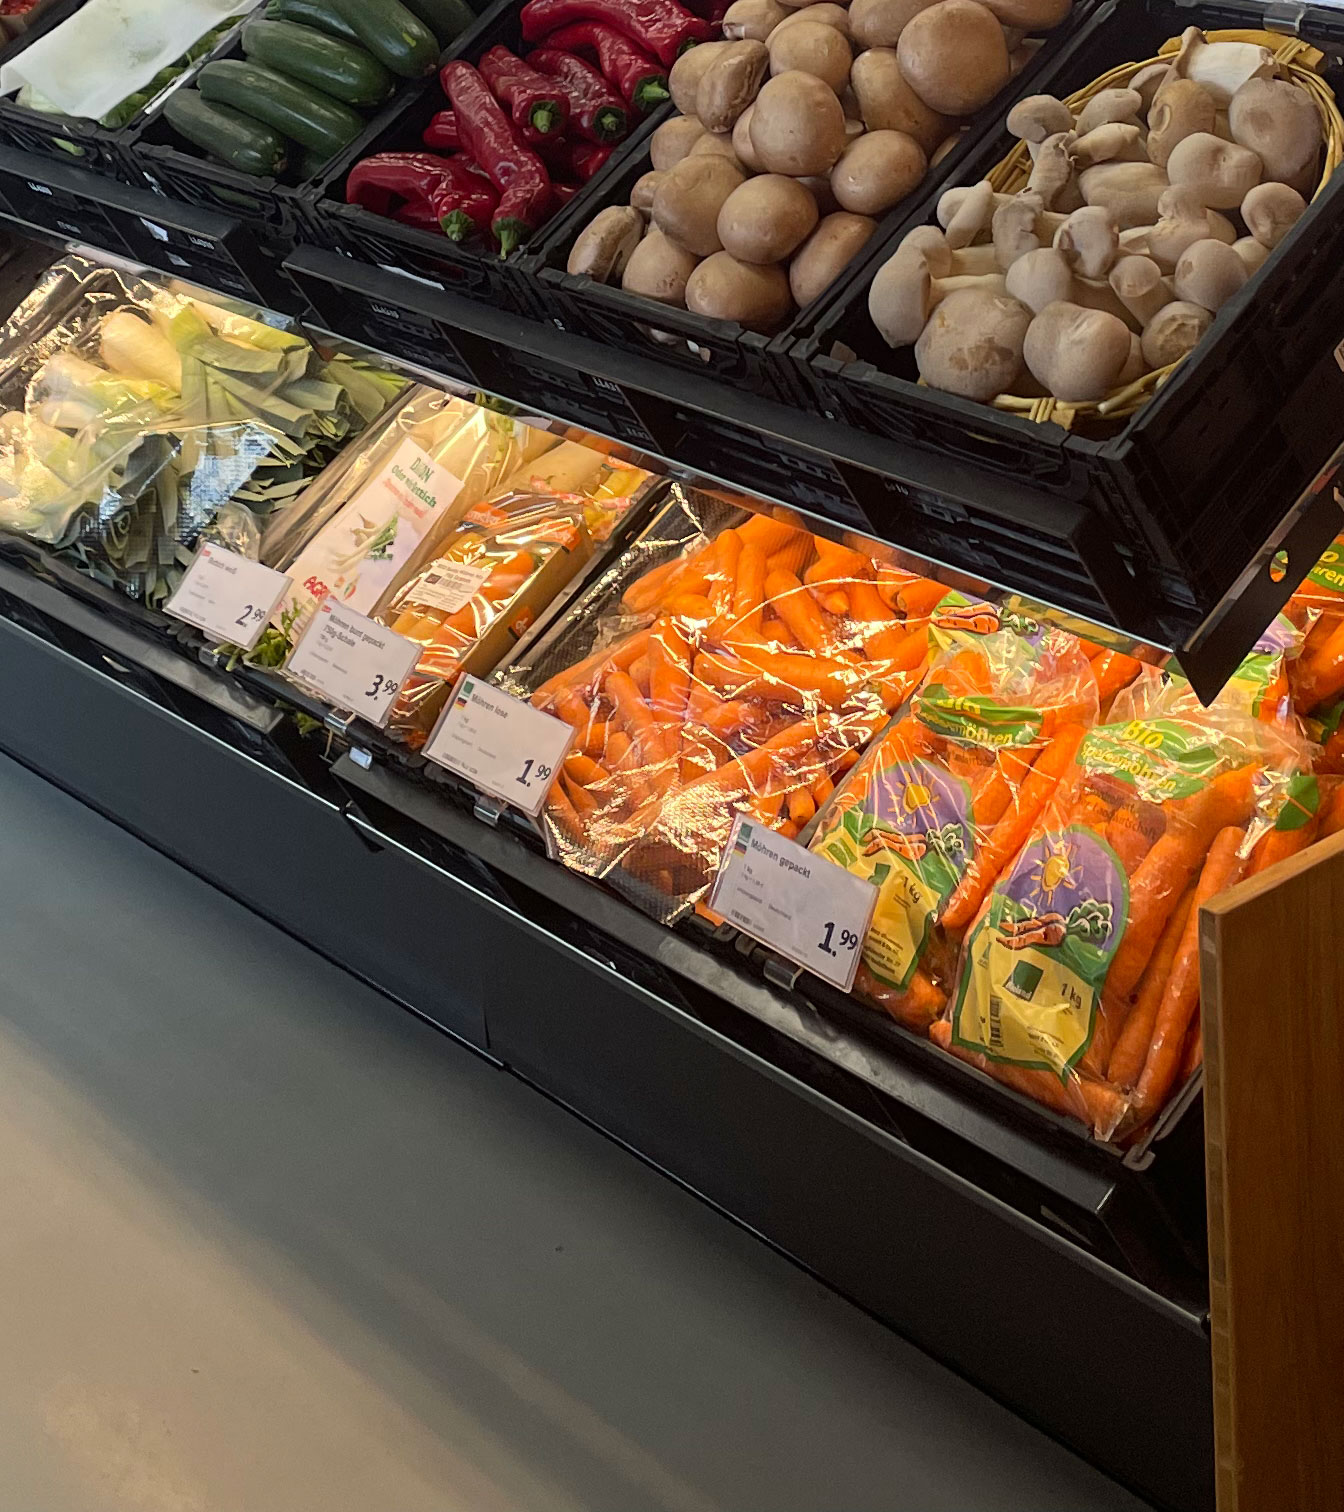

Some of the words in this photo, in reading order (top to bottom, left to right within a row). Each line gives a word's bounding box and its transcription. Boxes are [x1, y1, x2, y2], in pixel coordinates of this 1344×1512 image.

[235, 604, 266, 628] 2.99
[329, 614, 350, 630] Möhren
[361, 633, 385, 649] gepackt
[365, 674, 398, 701] 3.99
[470, 693, 494, 711] Möhren
[494, 705, 508, 719] lose
[1122, 720, 1165, 749] Bio
[515, 759, 552, 787] 1.99
[750, 838, 779, 862] Möhren
[779, 854, 811, 879] gepackt
[817, 921, 859, 958] 1.99
[1061, 983, 1068, 996] 1
[1069, 987, 1082, 1009] kg
